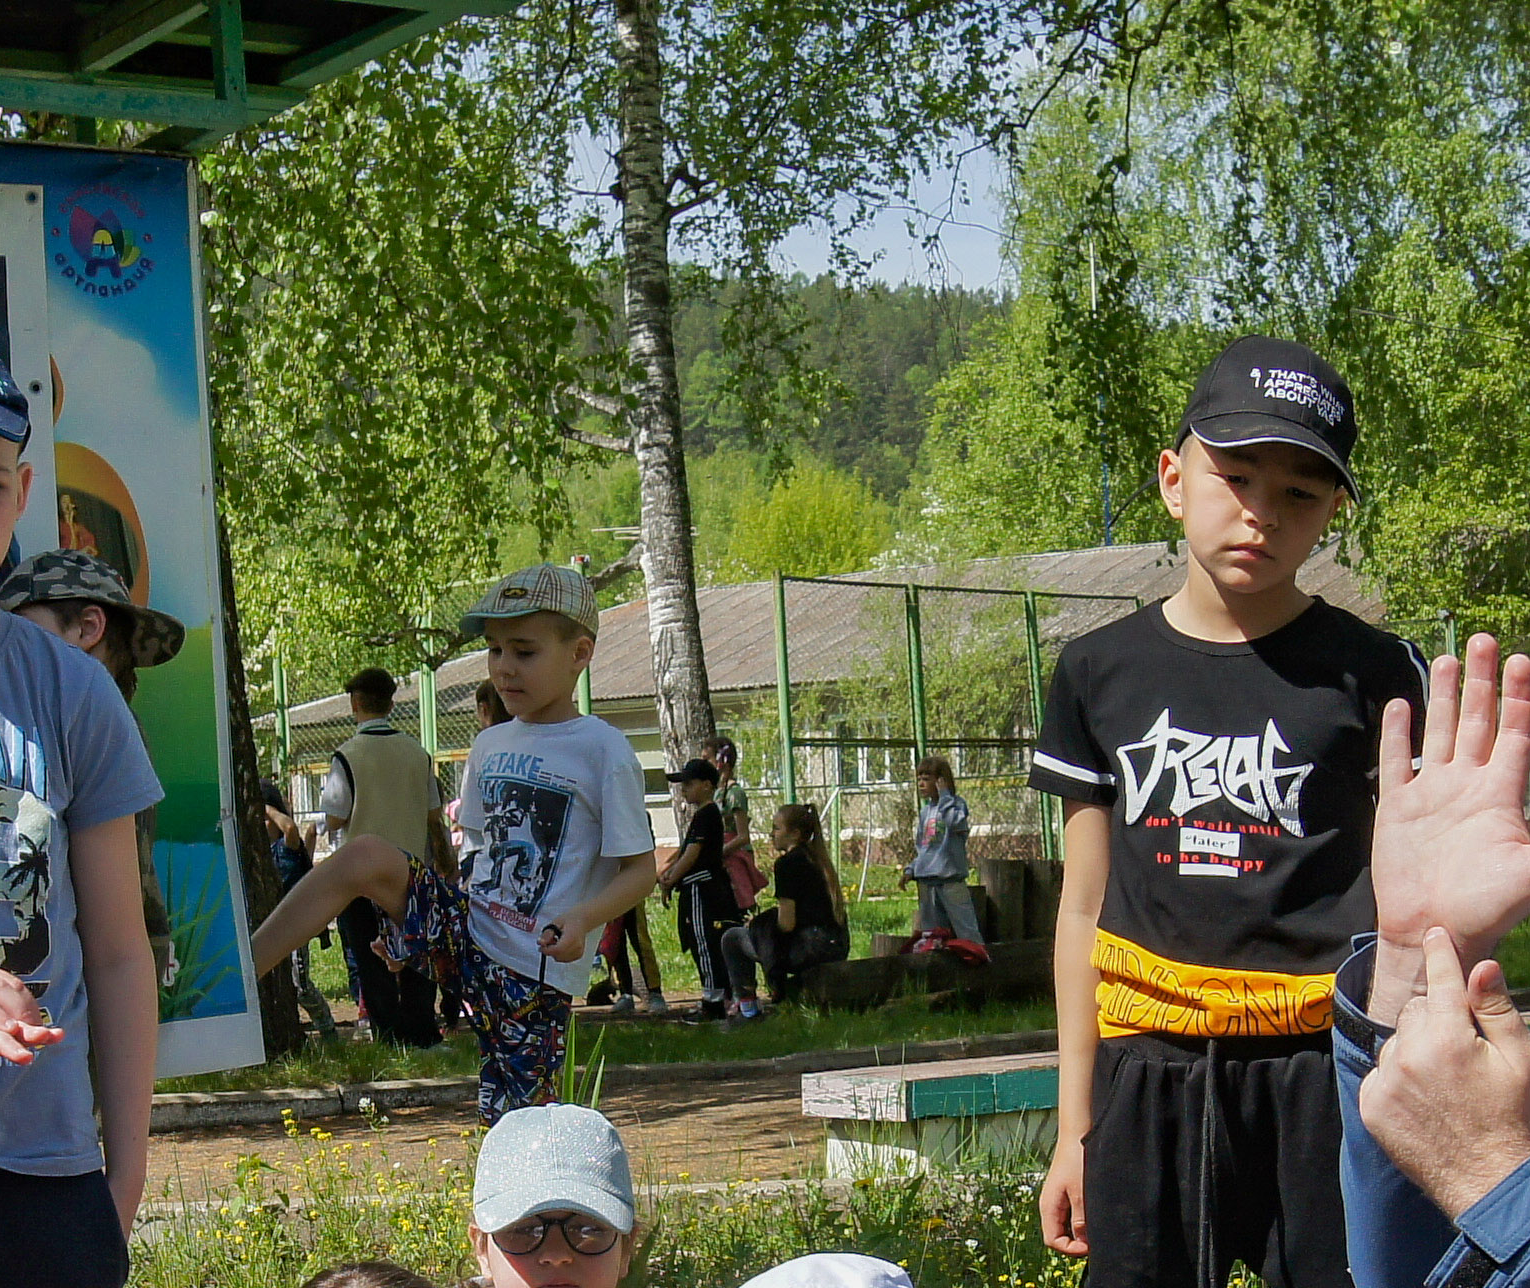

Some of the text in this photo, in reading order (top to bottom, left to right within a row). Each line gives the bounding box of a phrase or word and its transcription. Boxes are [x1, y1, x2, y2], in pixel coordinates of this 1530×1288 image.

[1268, 369, 1318, 389] THAT'S
[1264, 387, 1316, 408] ABOUT
[1145, 815, 1185, 828] don't
[1193, 819, 1234, 833] wait
[1157, 851, 1265, 872] to be happy
